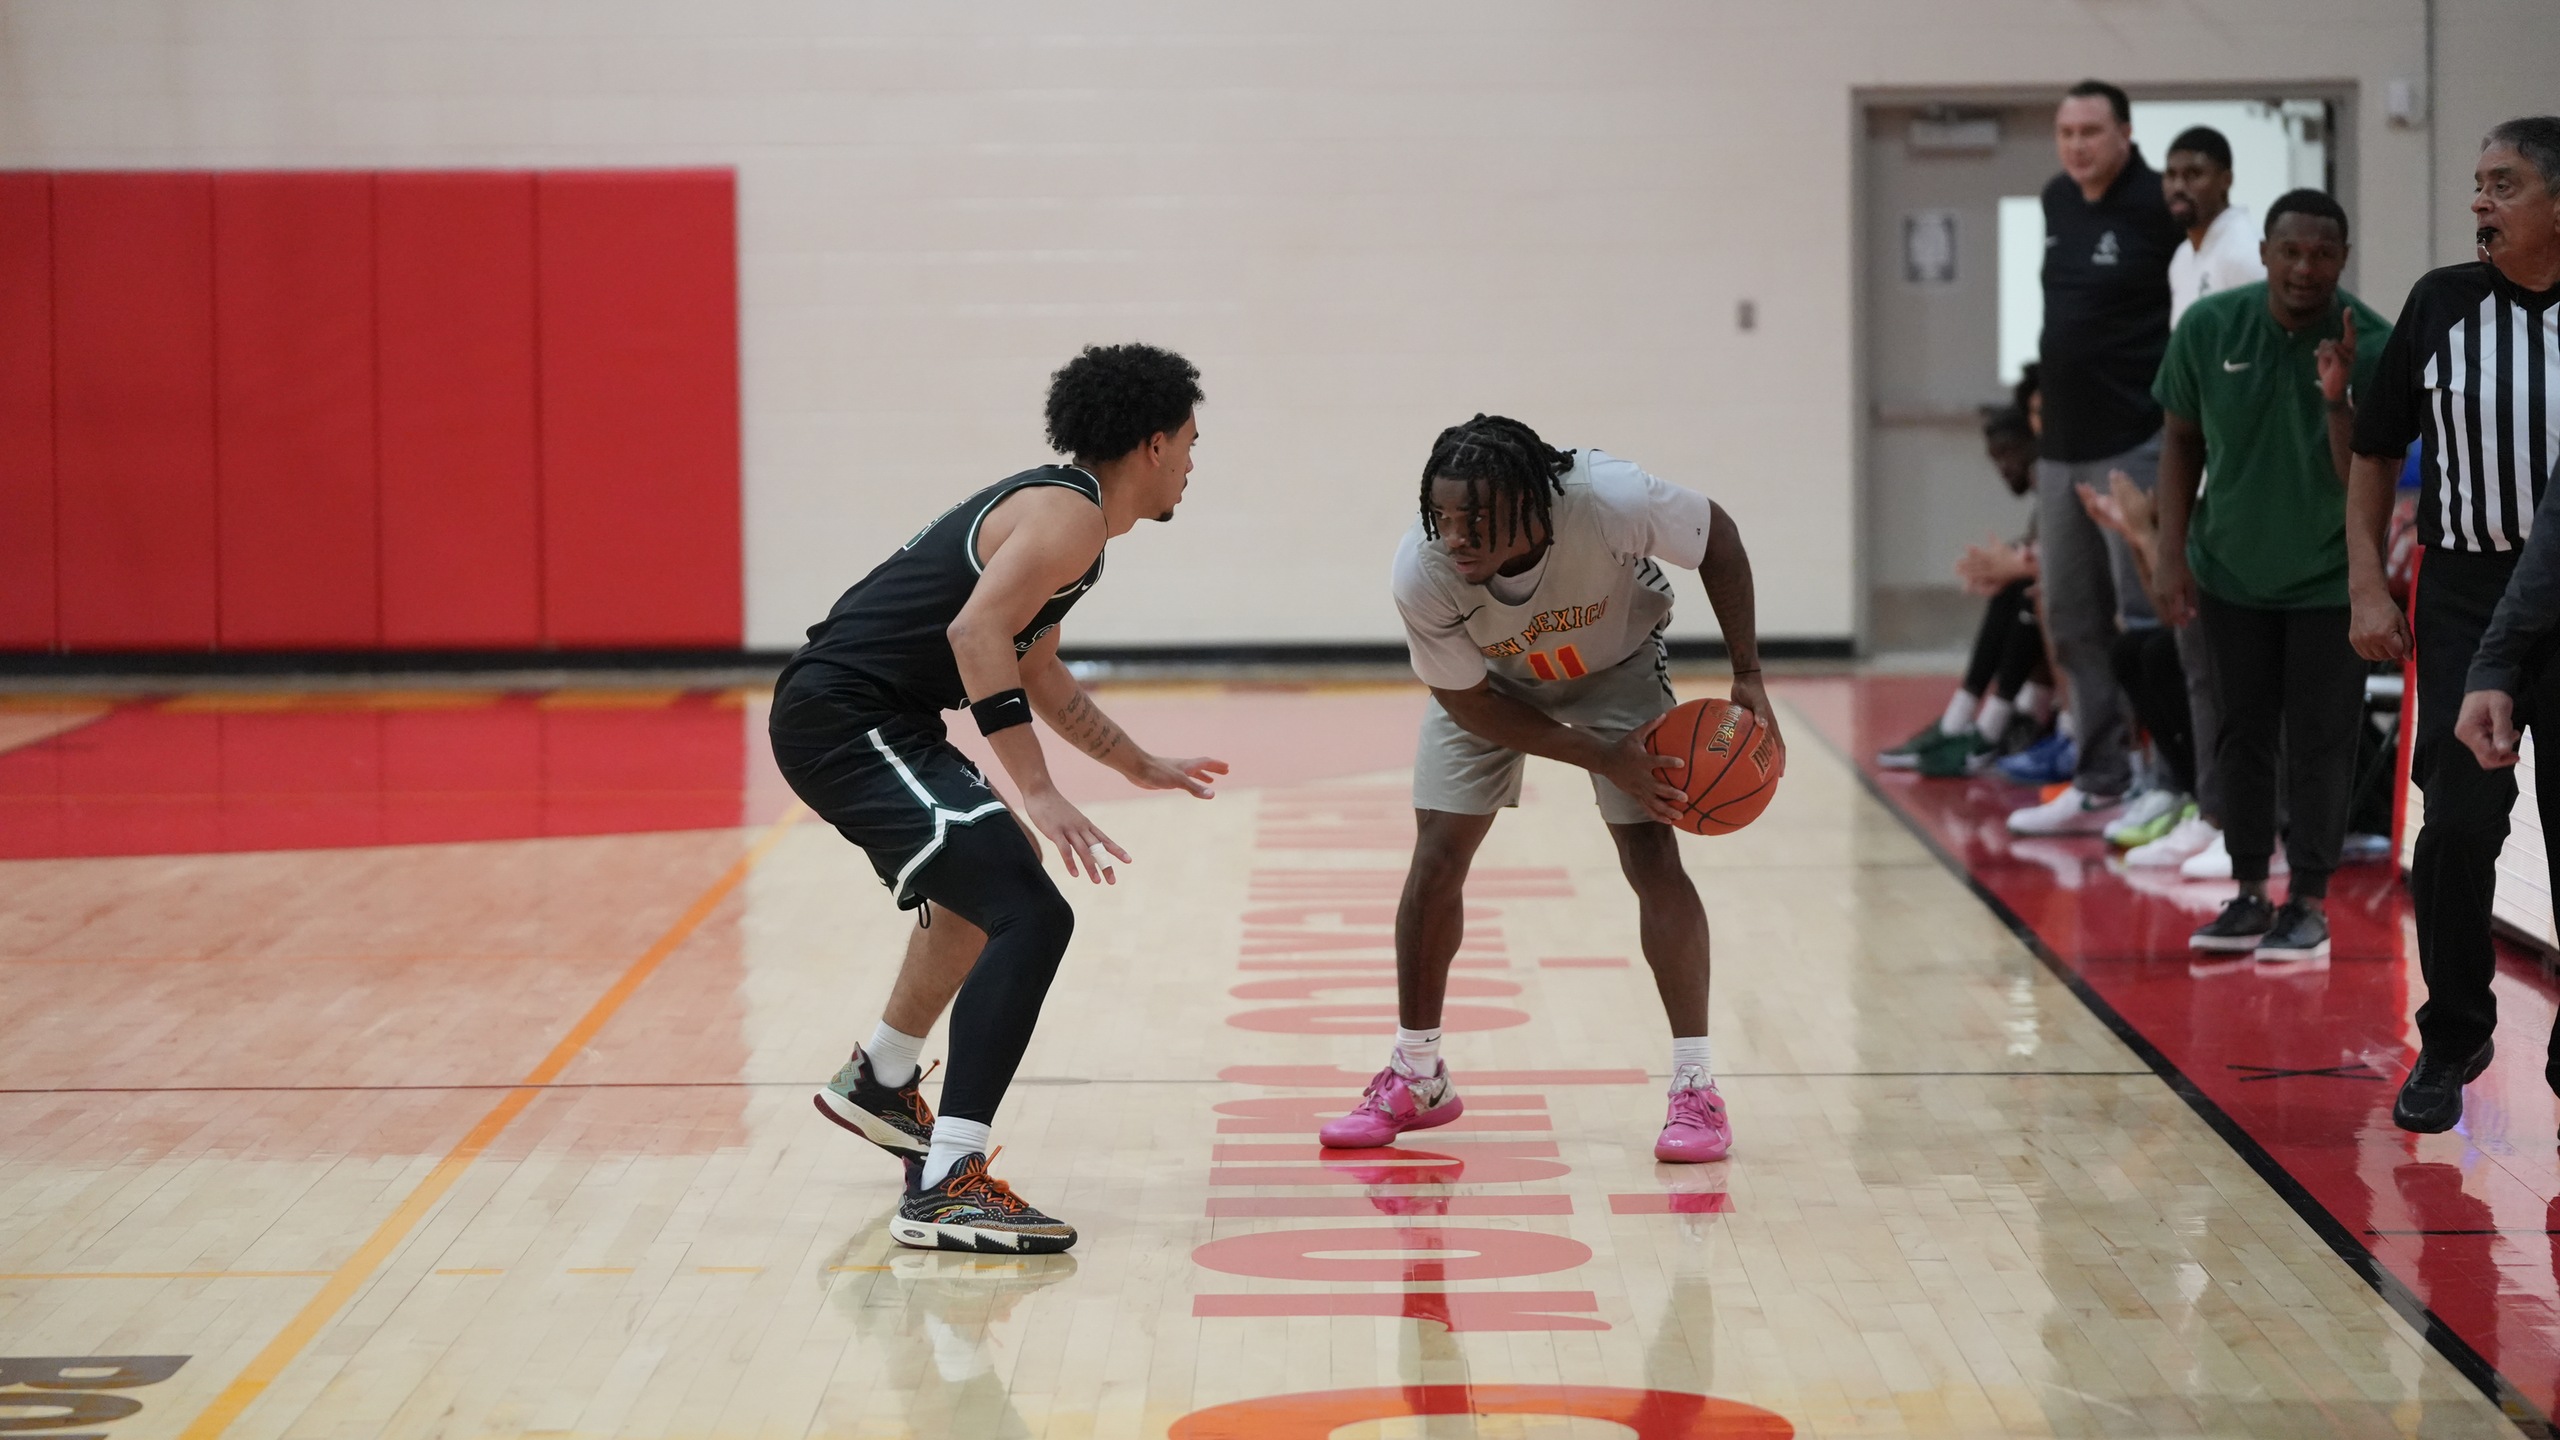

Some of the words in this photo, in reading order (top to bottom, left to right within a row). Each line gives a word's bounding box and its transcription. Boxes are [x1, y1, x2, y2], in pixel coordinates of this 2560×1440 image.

[1520, 595, 1609, 646] MEXICO
[1528, 643, 1588, 681] 11
[1190, 1063, 1738, 1332] Junior
